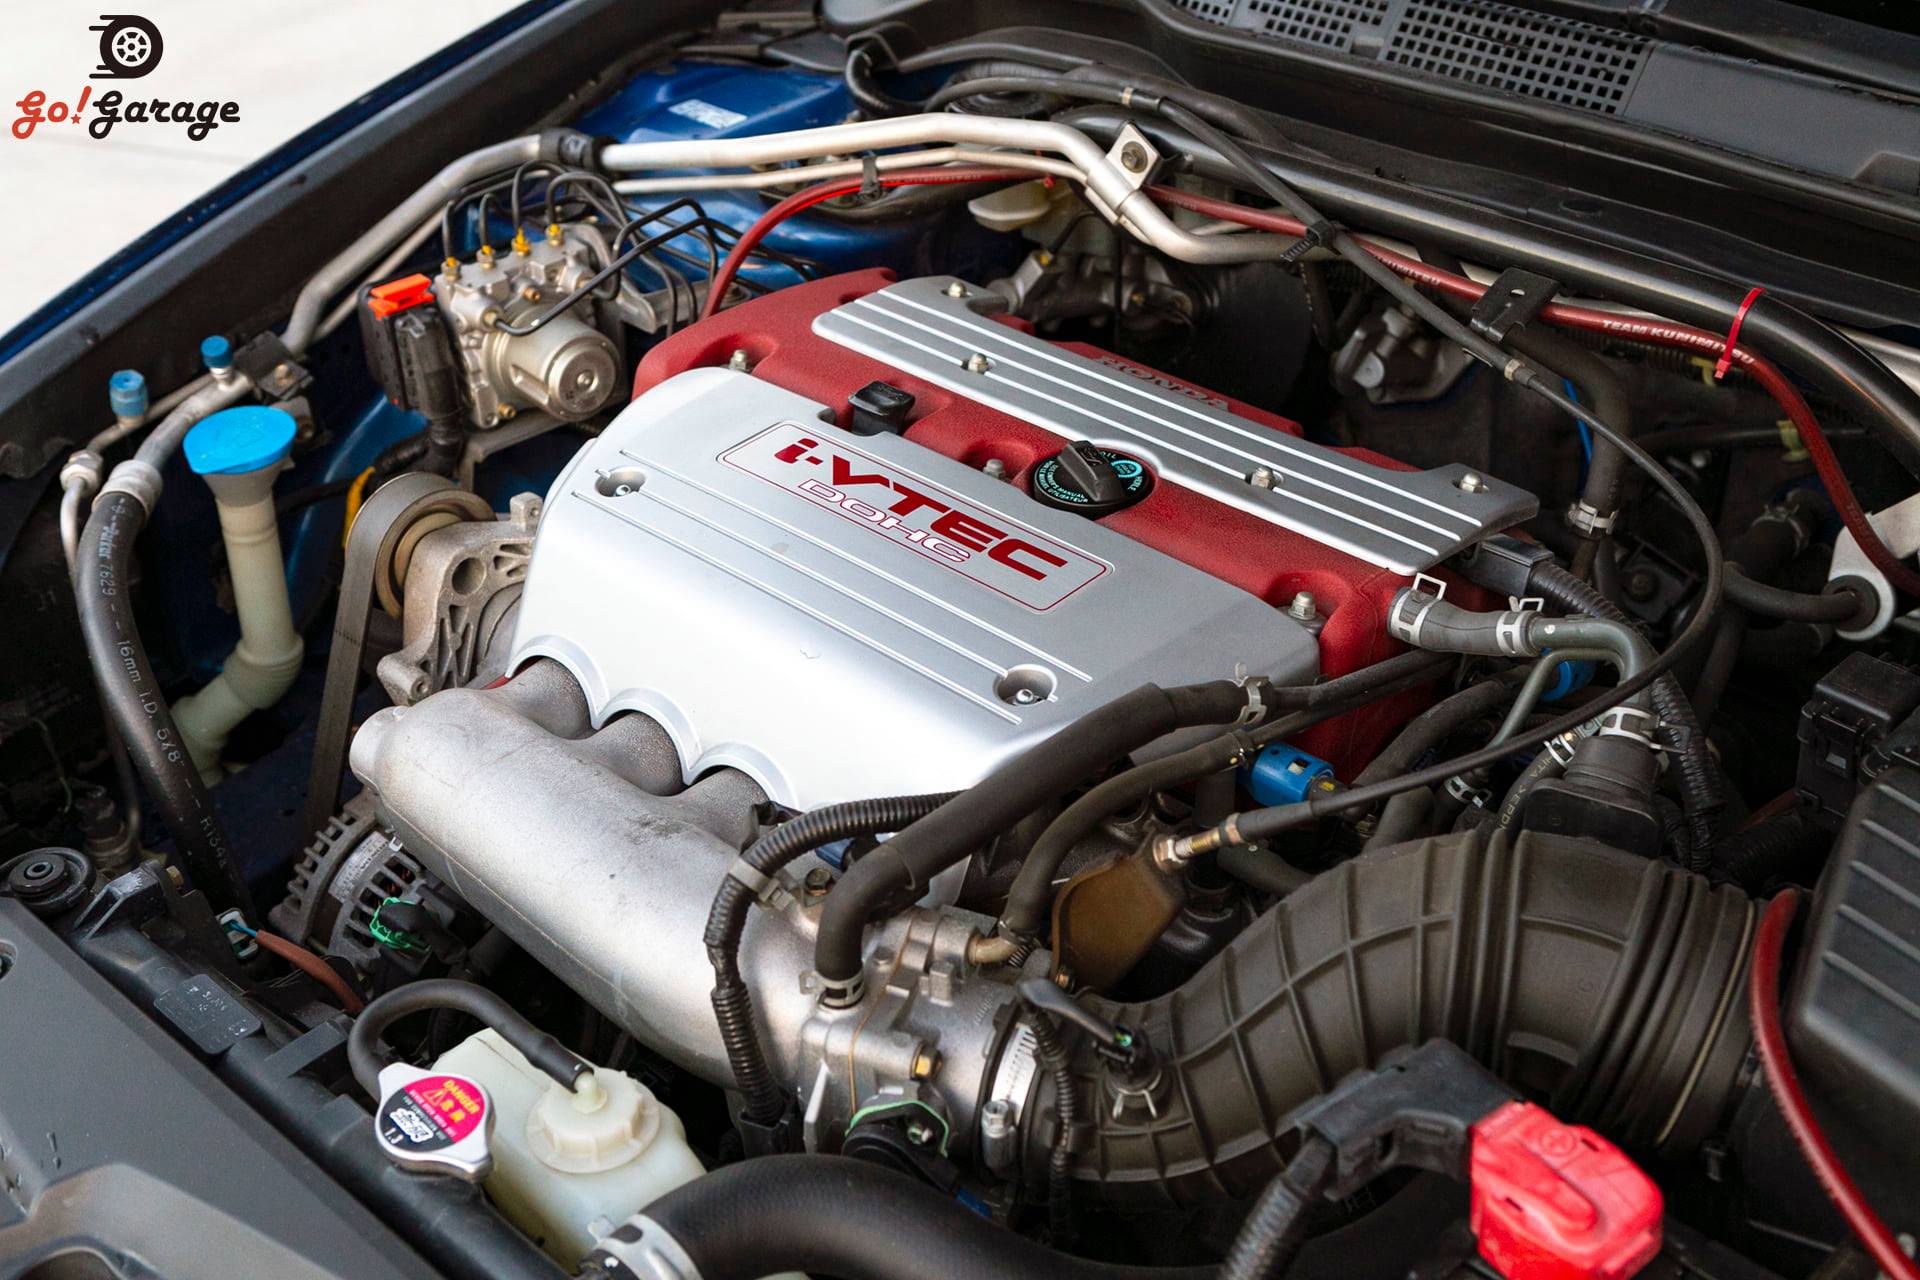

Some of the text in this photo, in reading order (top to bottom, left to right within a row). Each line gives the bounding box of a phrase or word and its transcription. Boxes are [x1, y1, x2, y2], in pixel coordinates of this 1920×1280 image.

[1602, 319, 1648, 335] TEAM
[774, 437, 1069, 581] i-VTEC
[797, 478, 971, 563] DOHC
[99, 563, 116, 596] 7629
[117, 639, 142, 683] 16mm
[443, 1079, 480, 1114] DANGER
